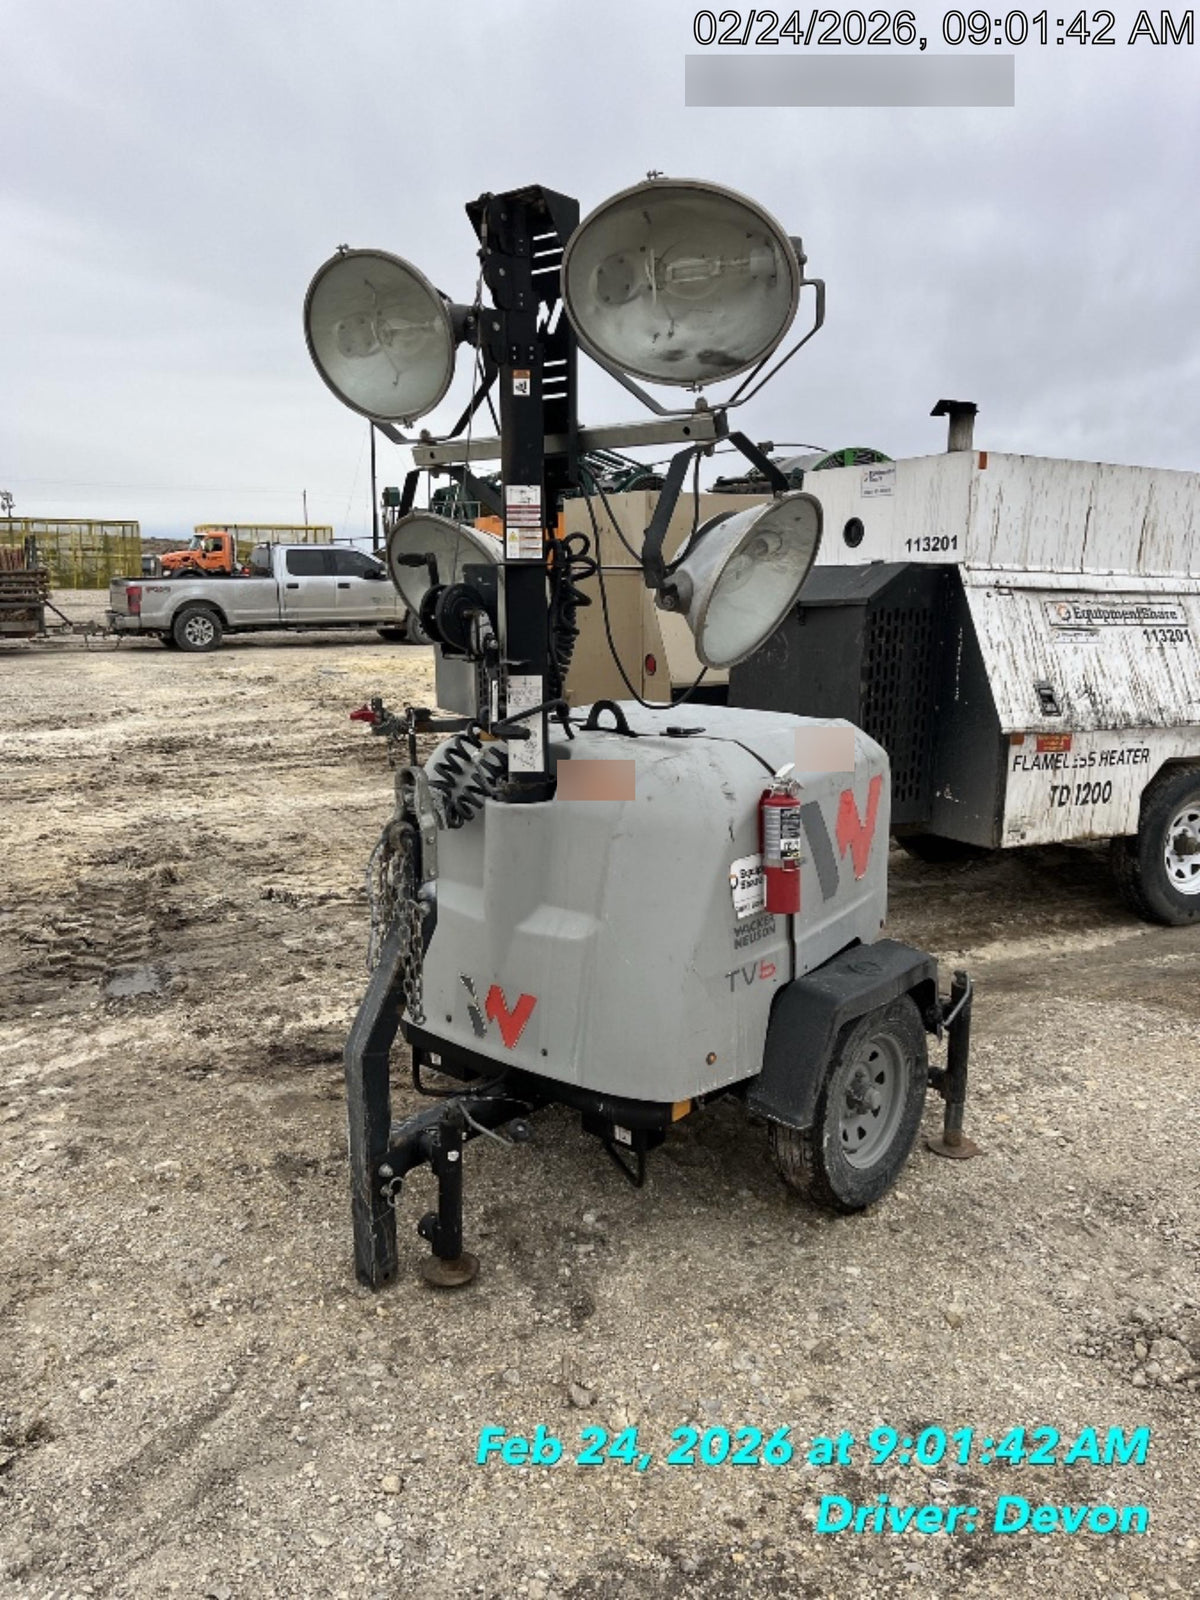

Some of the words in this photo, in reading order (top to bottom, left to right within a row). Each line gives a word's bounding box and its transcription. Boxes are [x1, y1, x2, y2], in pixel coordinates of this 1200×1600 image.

[905, 535, 958, 553] 113201
[1142, 628, 1192, 644] 113201
[1098, 747, 1151, 768] HEATER
[733, 922, 776, 950] NEUSON
